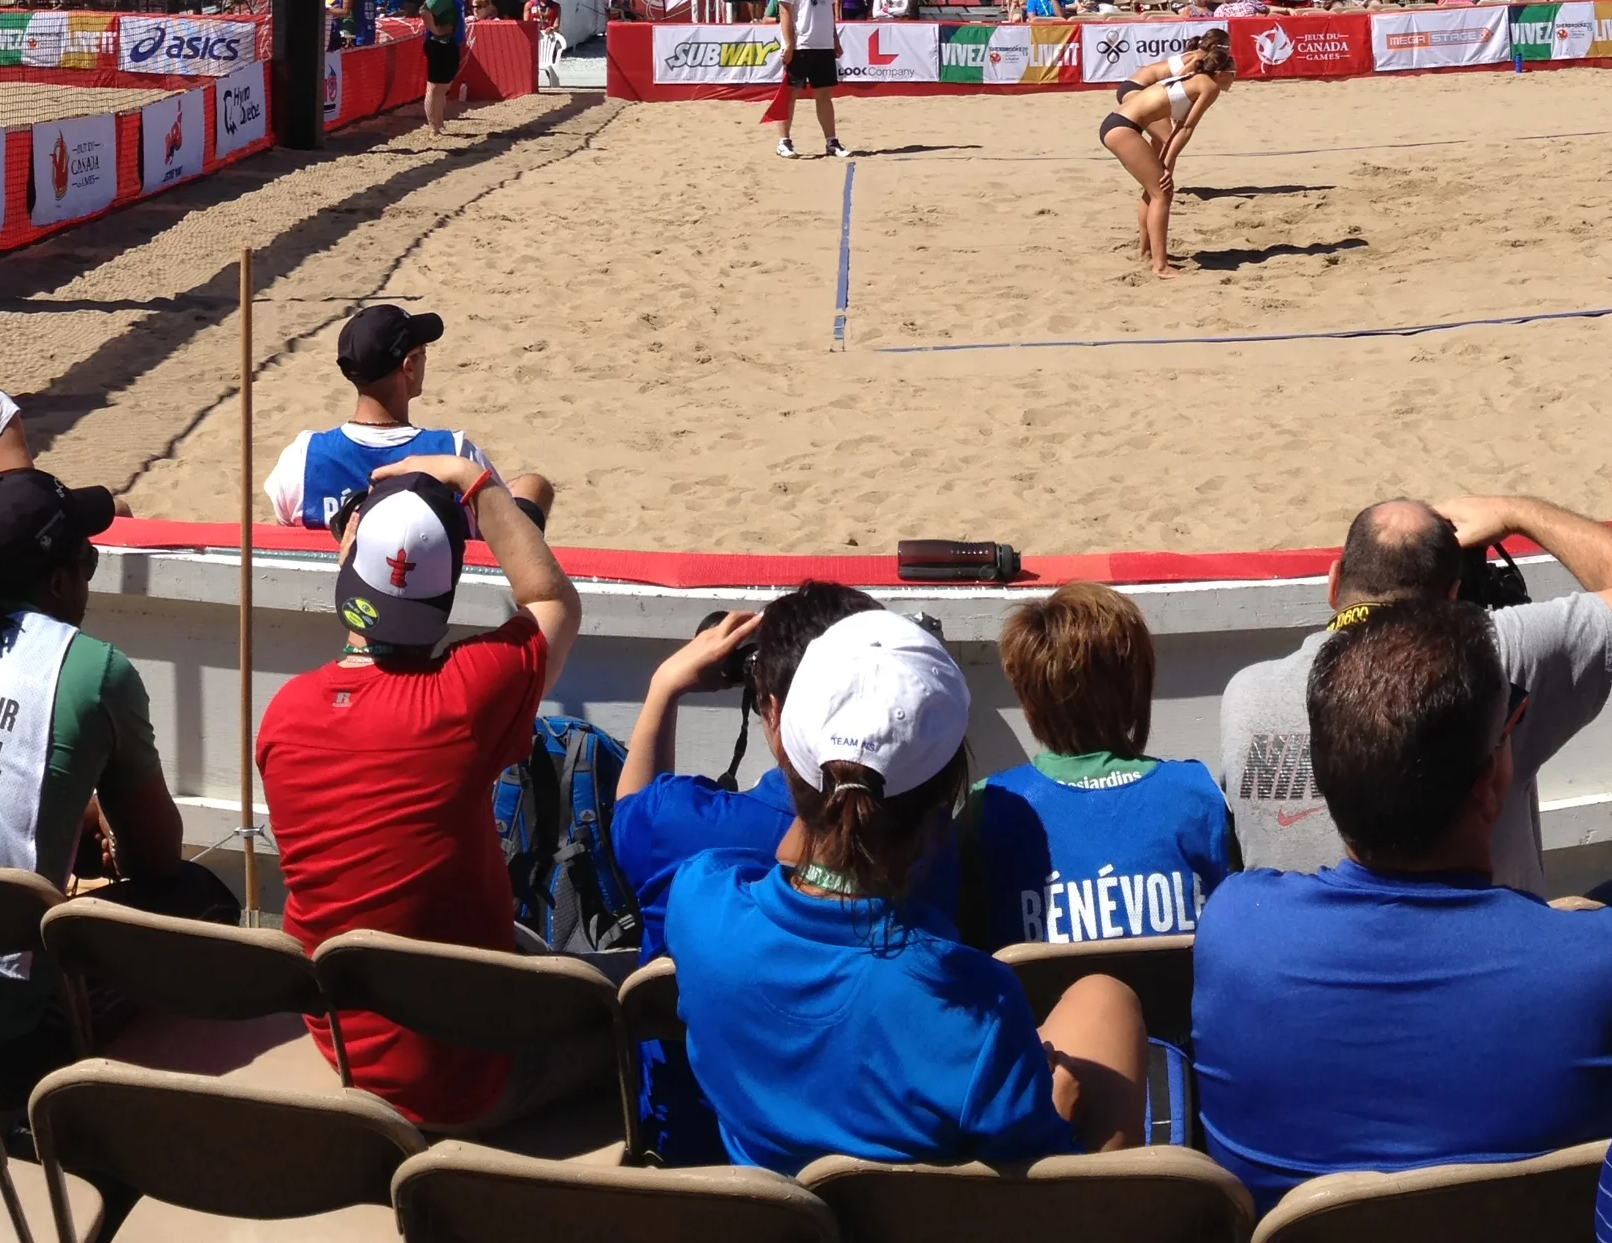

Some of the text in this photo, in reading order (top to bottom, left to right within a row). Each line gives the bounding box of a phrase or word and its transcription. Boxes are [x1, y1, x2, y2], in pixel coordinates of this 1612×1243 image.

[1389, 31, 1476, 47] MEGA STAGE
[1510, 21, 1553, 45] VIVEZ
[165, 33, 241, 61] asics
[665, 37, 781, 71] SUBWAY
[941, 42, 987, 67] VIVEZ
[1030, 42, 1063, 67] LIVE
[1135, 37, 1191, 56] agro
[1297, 41, 1349, 53] CANADA
[1306, 52, 1340, 60] GAMES
[869, 67, 915, 78] Company
[830, 736, 859, 748] TEAM
[1021, 863, 1204, 945] BÉNÉVOLE
